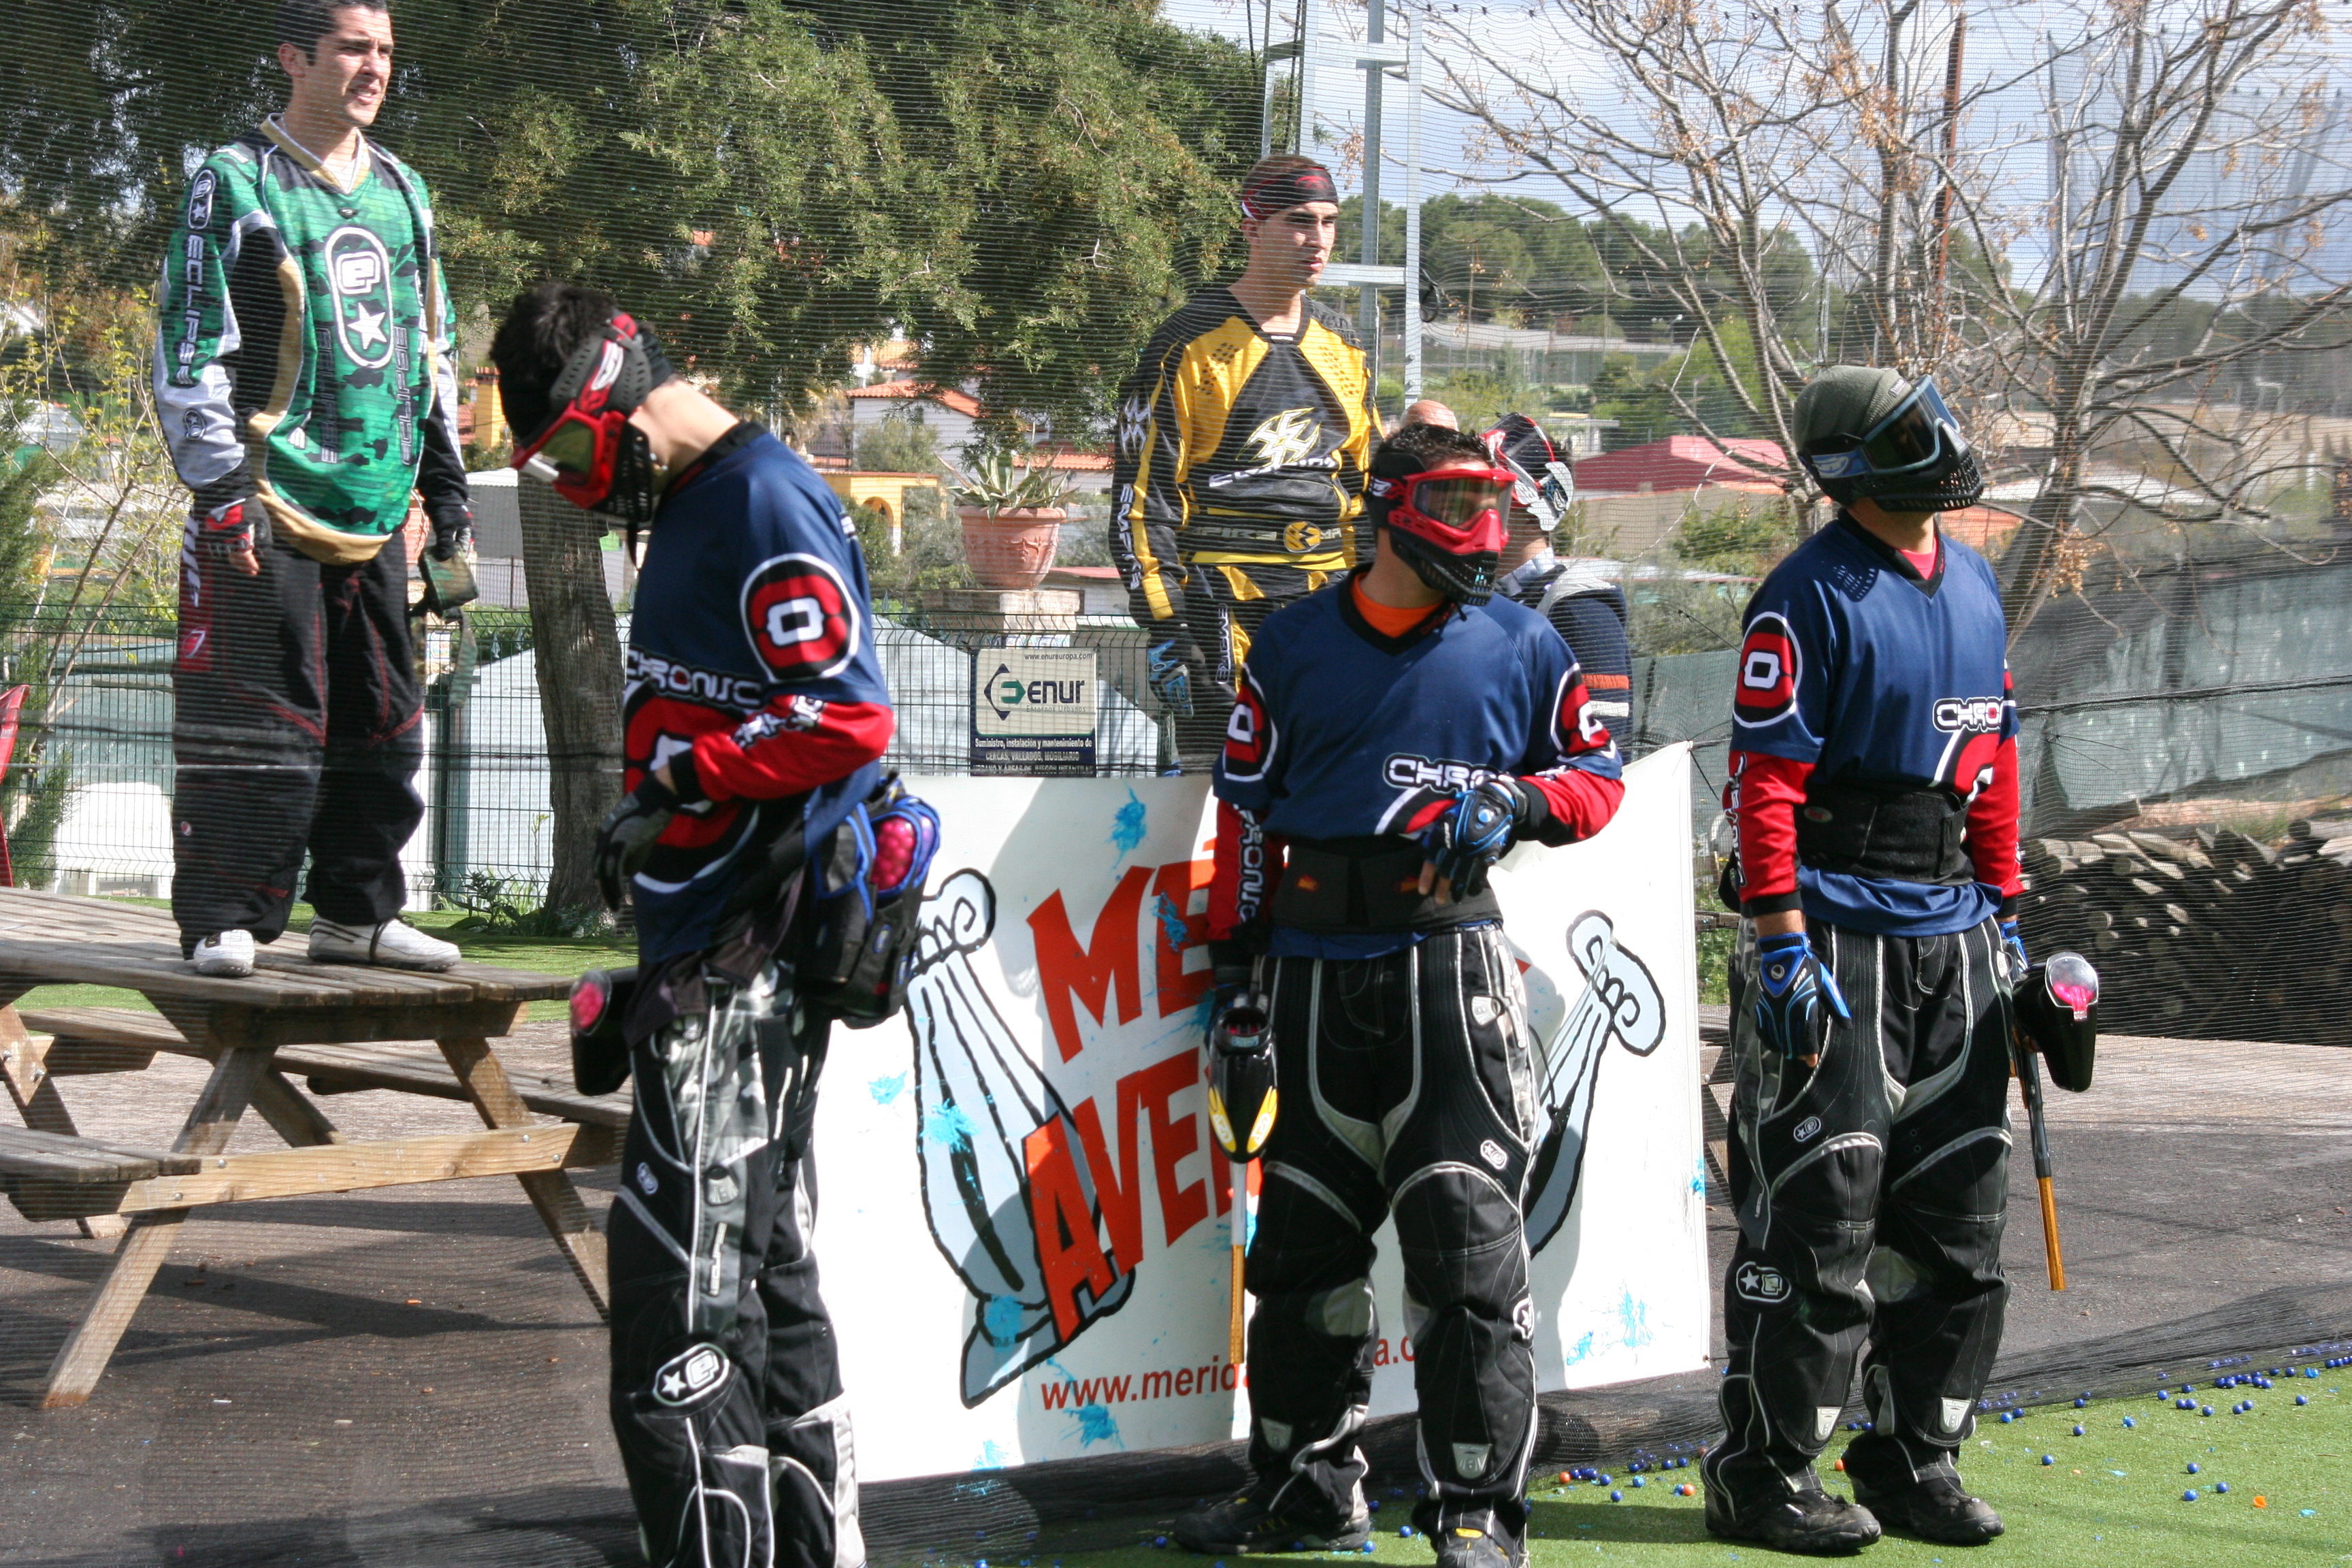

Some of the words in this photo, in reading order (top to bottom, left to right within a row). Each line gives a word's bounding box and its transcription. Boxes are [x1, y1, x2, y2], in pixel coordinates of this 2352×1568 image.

[174, 234, 203, 385] ECLIPSE
[1024, 653, 1093, 662] www.enureuropa.com
[1027, 680, 1085, 704] enur
[1037, 740, 1042, 749] y
[1042, 738, 1084, 748] mantenimiento
[1085, 738, 1092, 747] de
[1026, 837, 1215, 1064] ME
